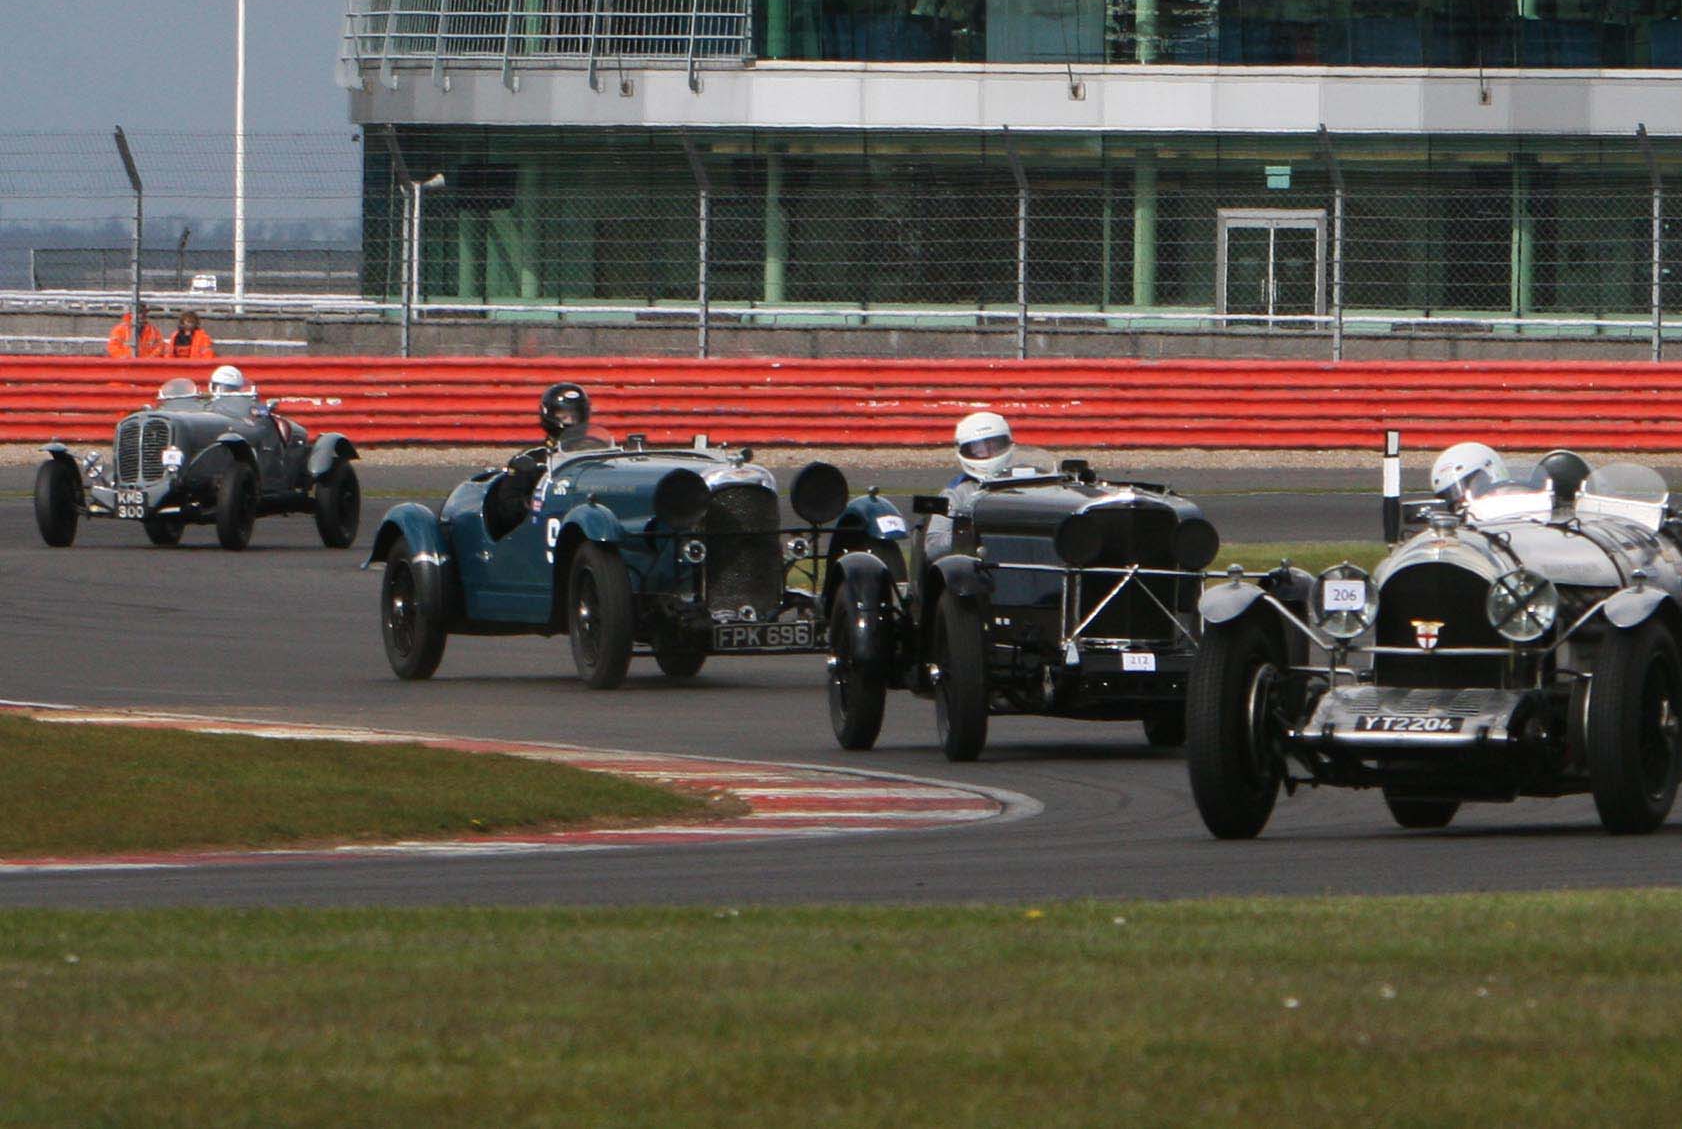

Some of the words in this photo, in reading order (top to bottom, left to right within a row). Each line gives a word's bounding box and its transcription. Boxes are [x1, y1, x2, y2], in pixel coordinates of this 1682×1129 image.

[118, 505, 144, 518] 300
[1333, 589, 1357, 601] 206
[720, 627, 760, 646] FPK
[767, 626, 808, 645] 696
[1131, 656, 1149, 665] 212
